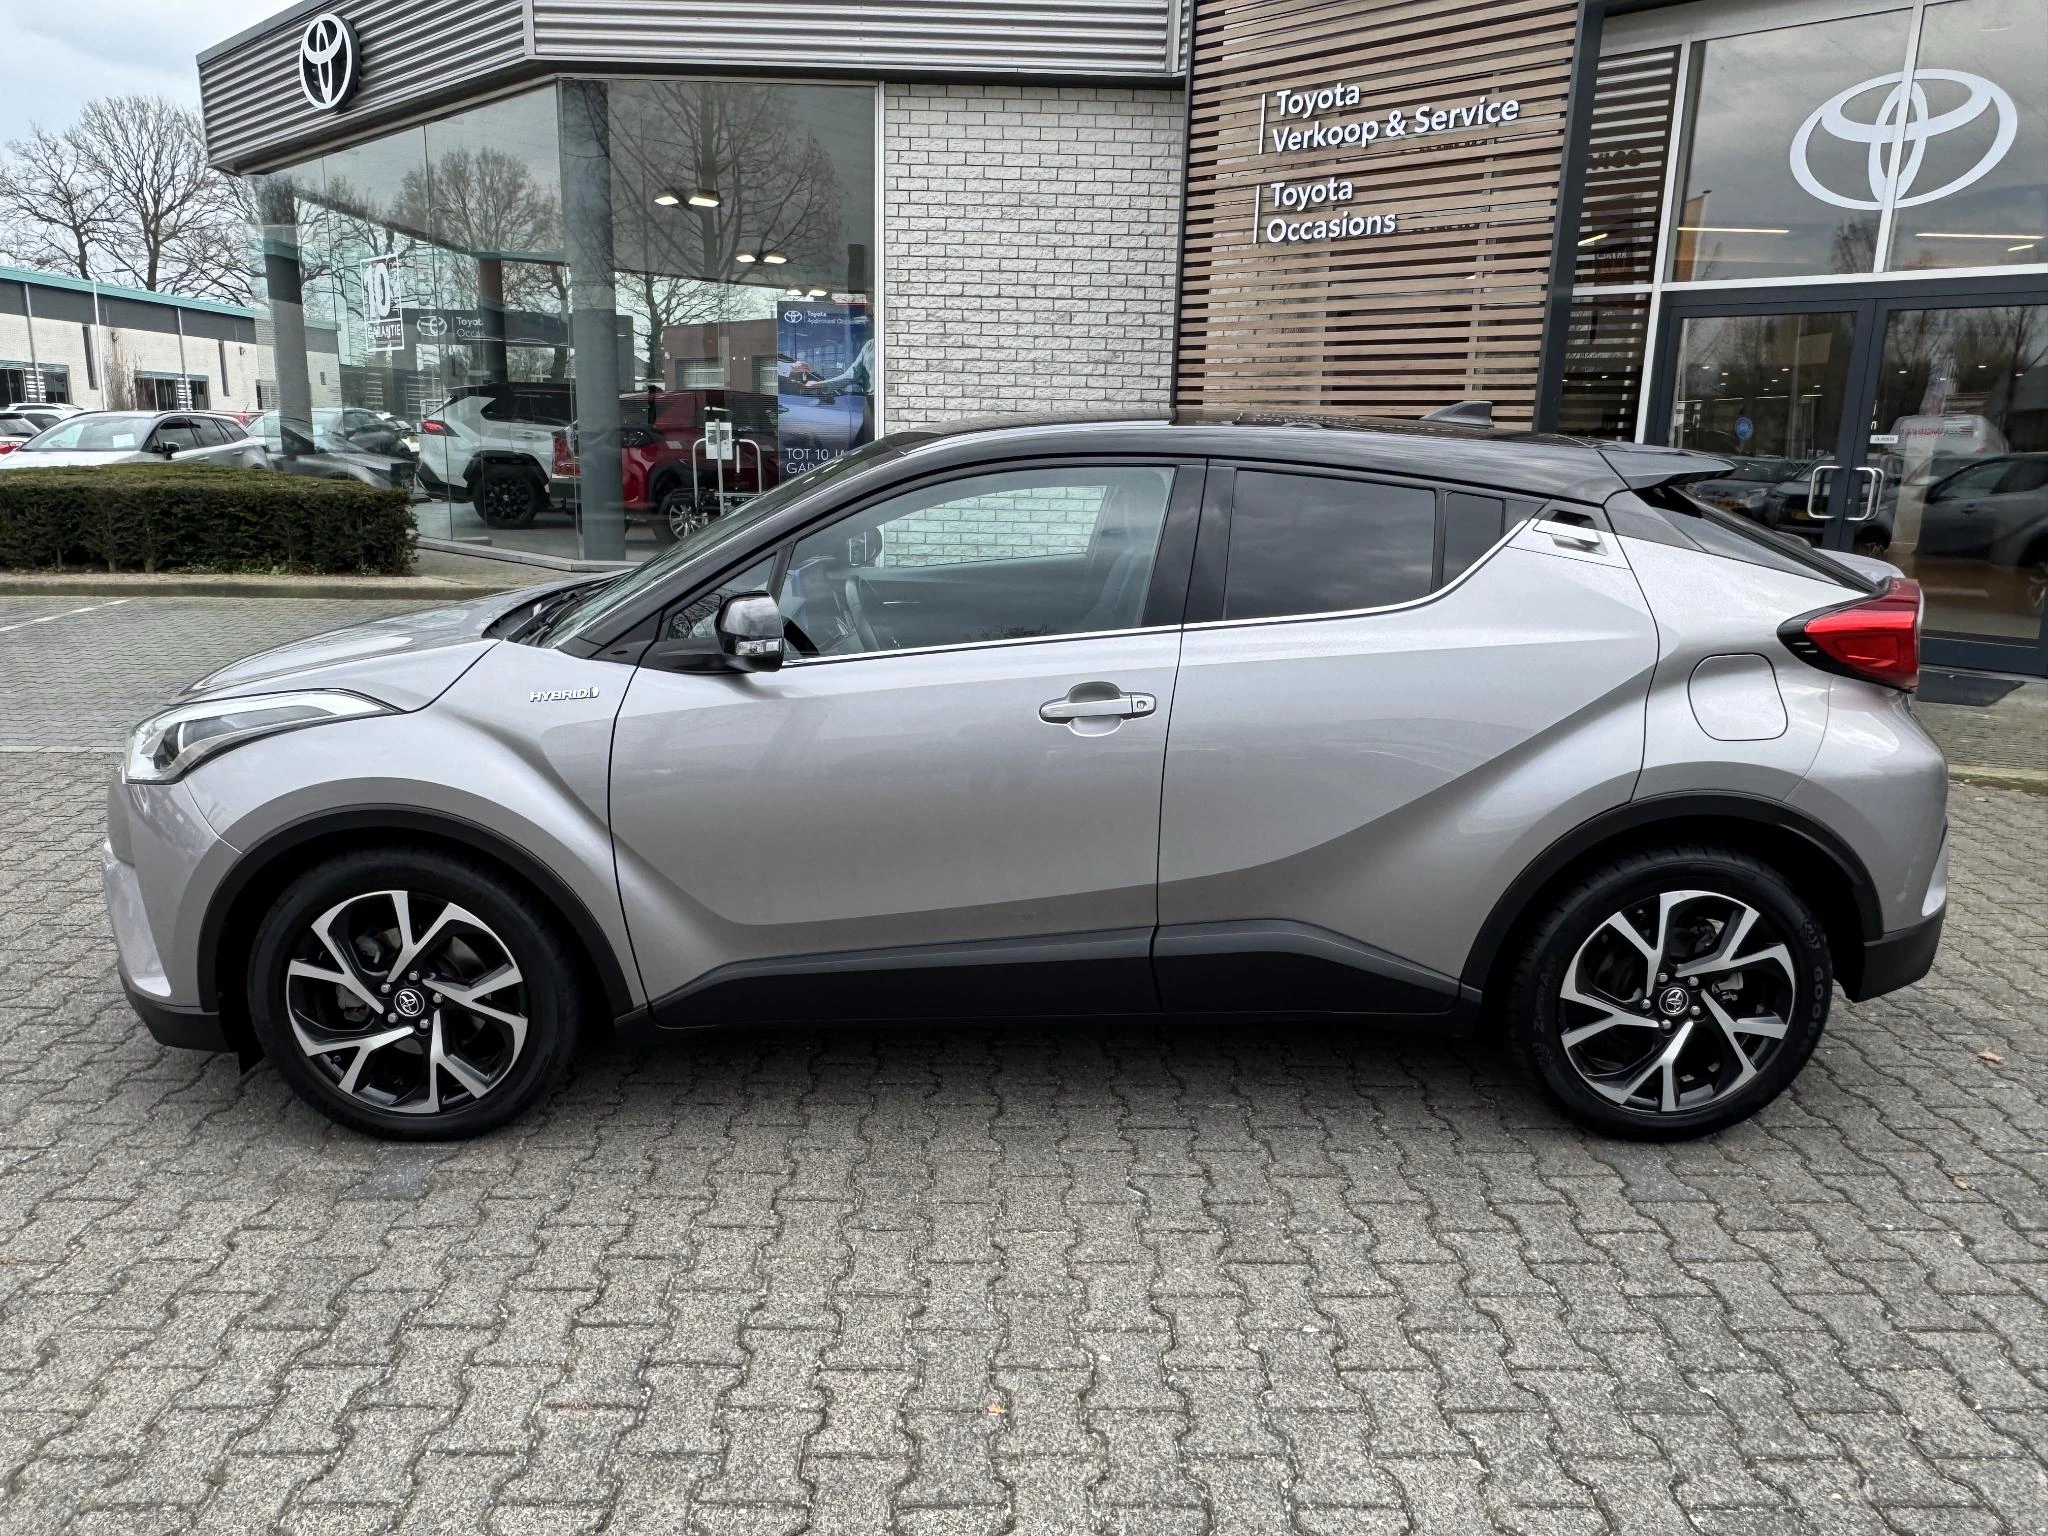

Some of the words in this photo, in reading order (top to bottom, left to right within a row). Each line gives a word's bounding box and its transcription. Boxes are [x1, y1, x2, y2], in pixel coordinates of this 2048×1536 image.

[1276, 82, 1361, 119] Toyota
[1272, 120, 1379, 153] Verkoop
[1385, 109, 1407, 137] &
[1414, 96, 1520, 134] Service
[1271, 176, 1354, 212] Toyota
[1266, 210, 1397, 244] Occasions
[807, 310, 827, 318] Toyota
[785, 447, 811, 460] TOT
[814, 449, 829, 461] 10
[529, 688, 589, 703] HYBRID
